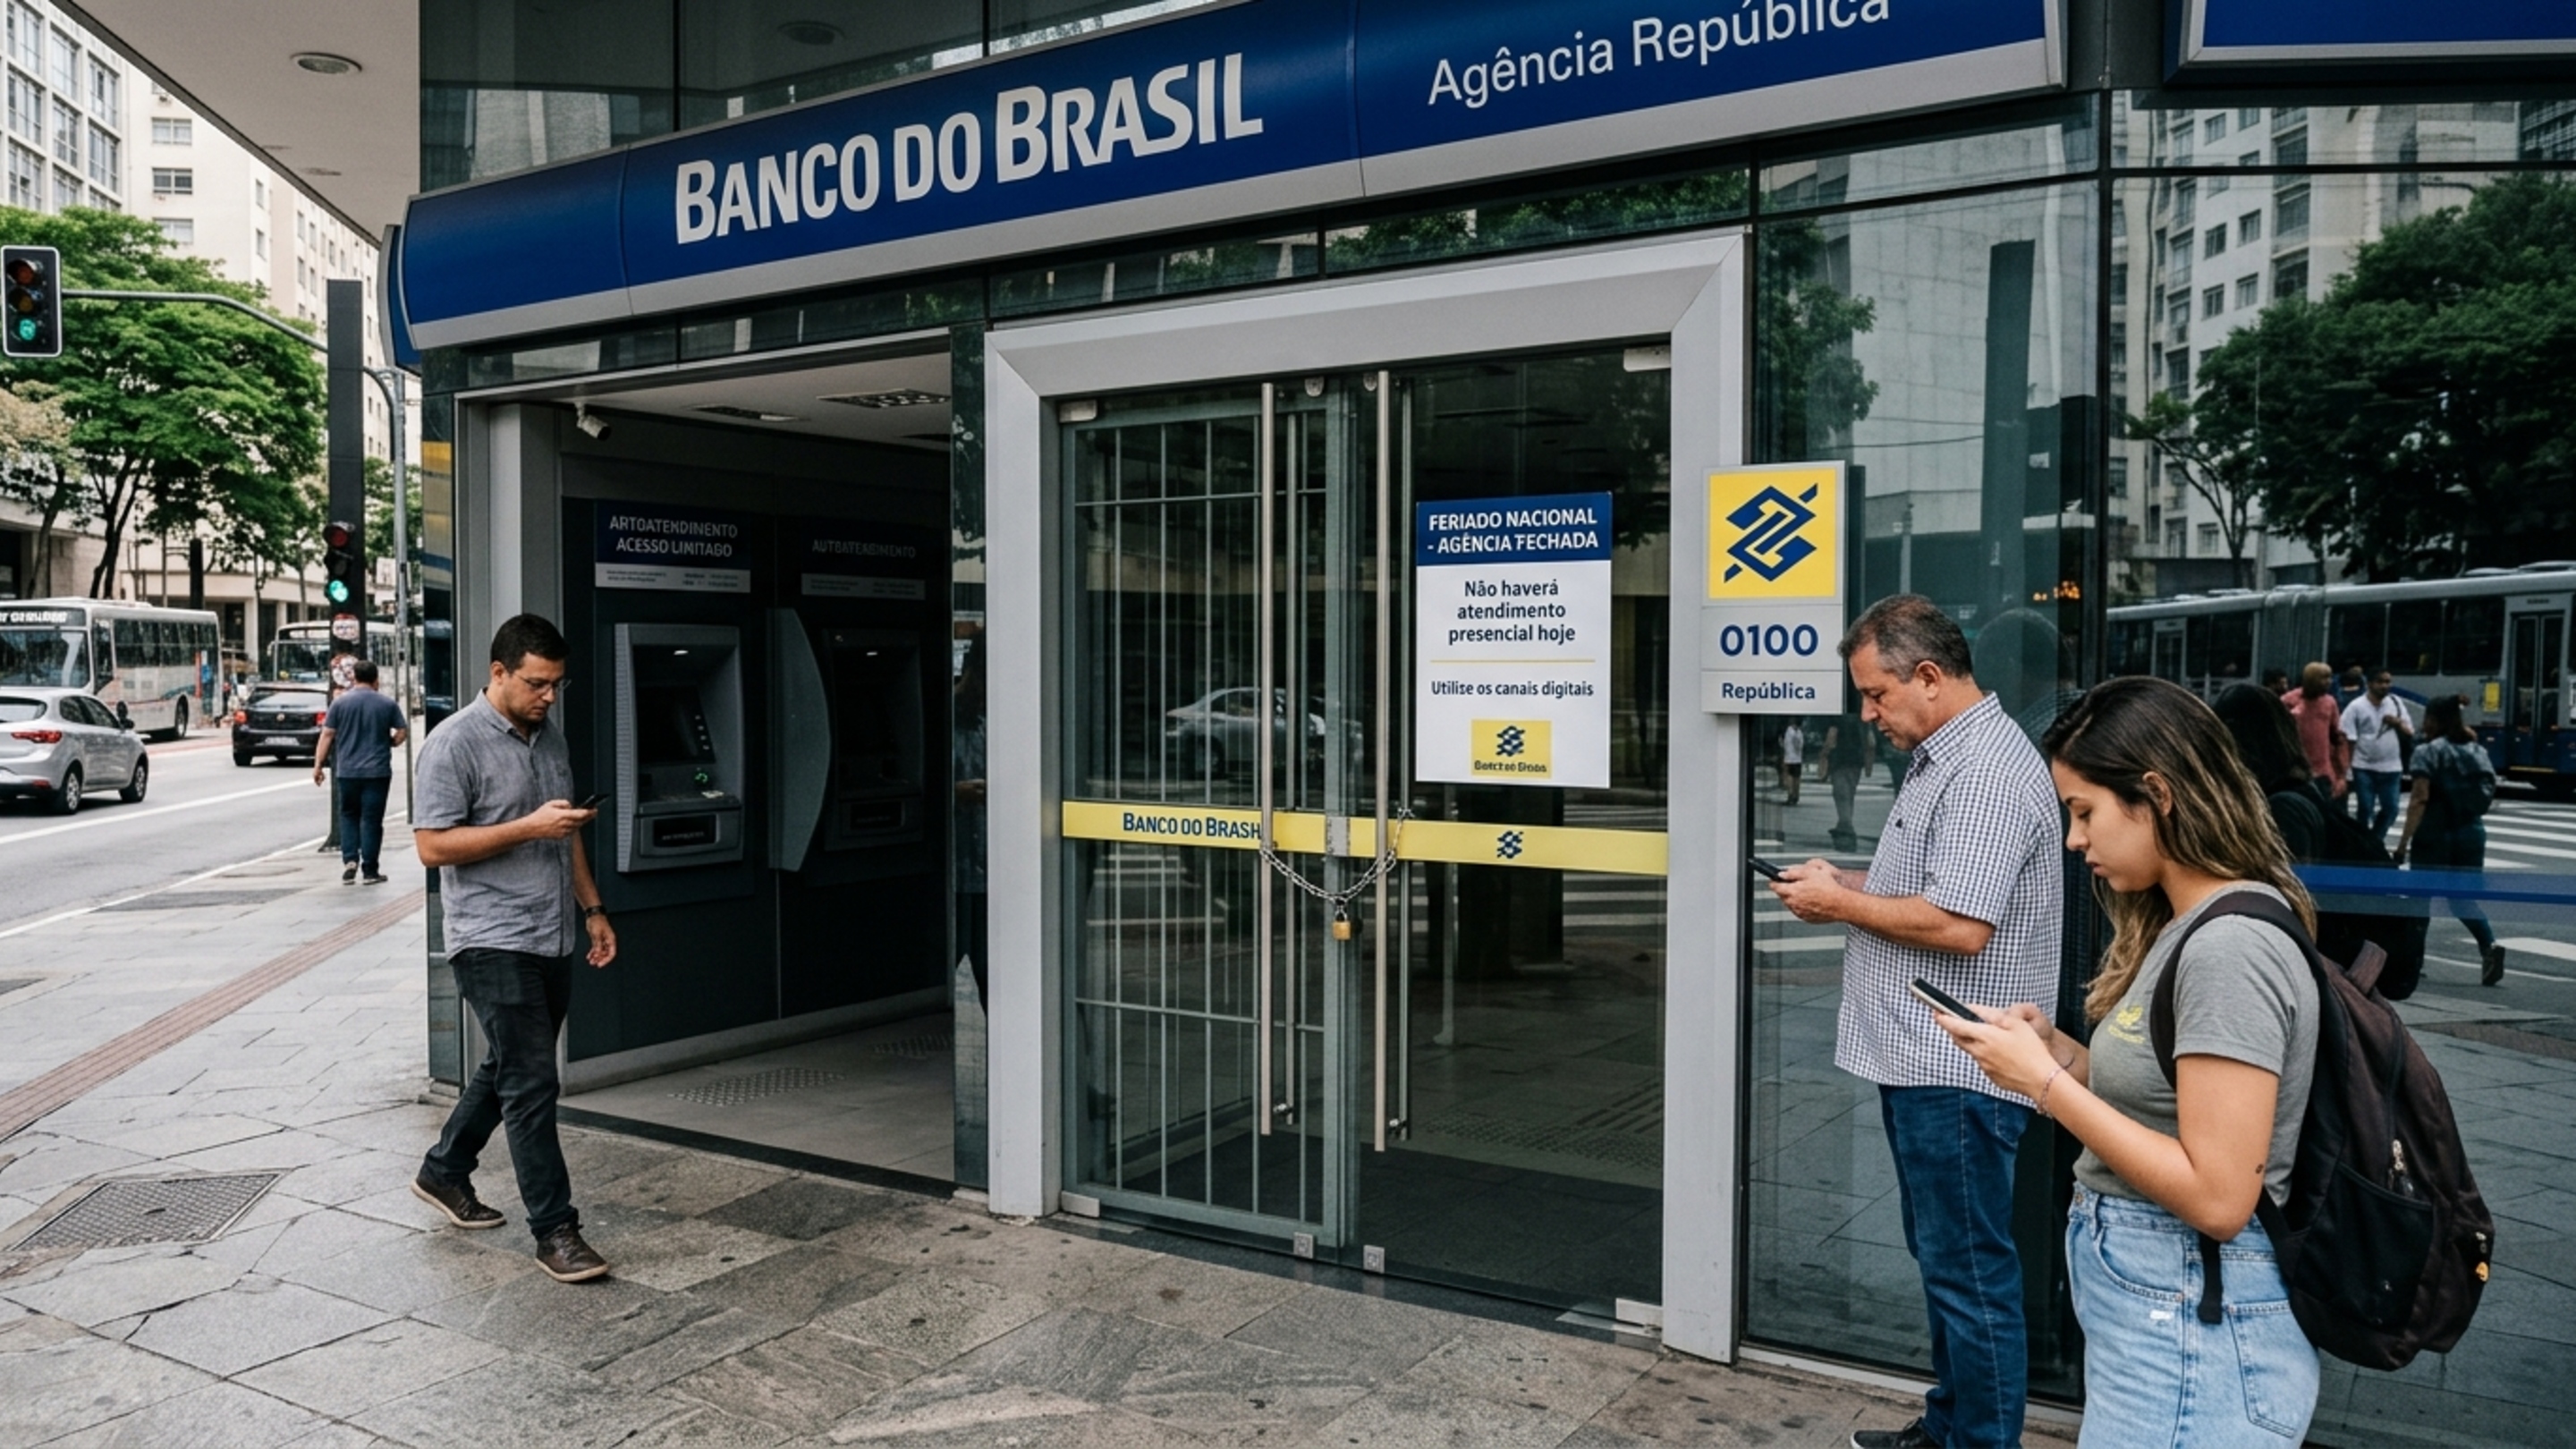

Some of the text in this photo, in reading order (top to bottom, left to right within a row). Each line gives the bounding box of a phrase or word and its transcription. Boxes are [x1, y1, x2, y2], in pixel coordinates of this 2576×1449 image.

[1428, 31, 1614, 109] Agência
[675, 52, 1264, 245] BANCO DO BRASIL
[1428, 508, 1597, 530] FERIADO NACIONAL
[616, 538, 669, 554] ACESSO
[1437, 532, 1512, 554] AGÊNCIA
[1514, 530, 1598, 551] FECHADA
[1464, 579, 1559, 597] Não haverá
[1457, 602, 1566, 620] atendimento
[1448, 623, 1576, 646] presencial hoje
[1720, 623, 1818, 657] 0100
[1477, 683, 1493, 695] os
[1495, 681, 1538, 695] canais
[1541, 681, 1594, 699] digitais
[1722, 682, 1816, 704] República
[1123, 812, 1178, 835] BANCO
